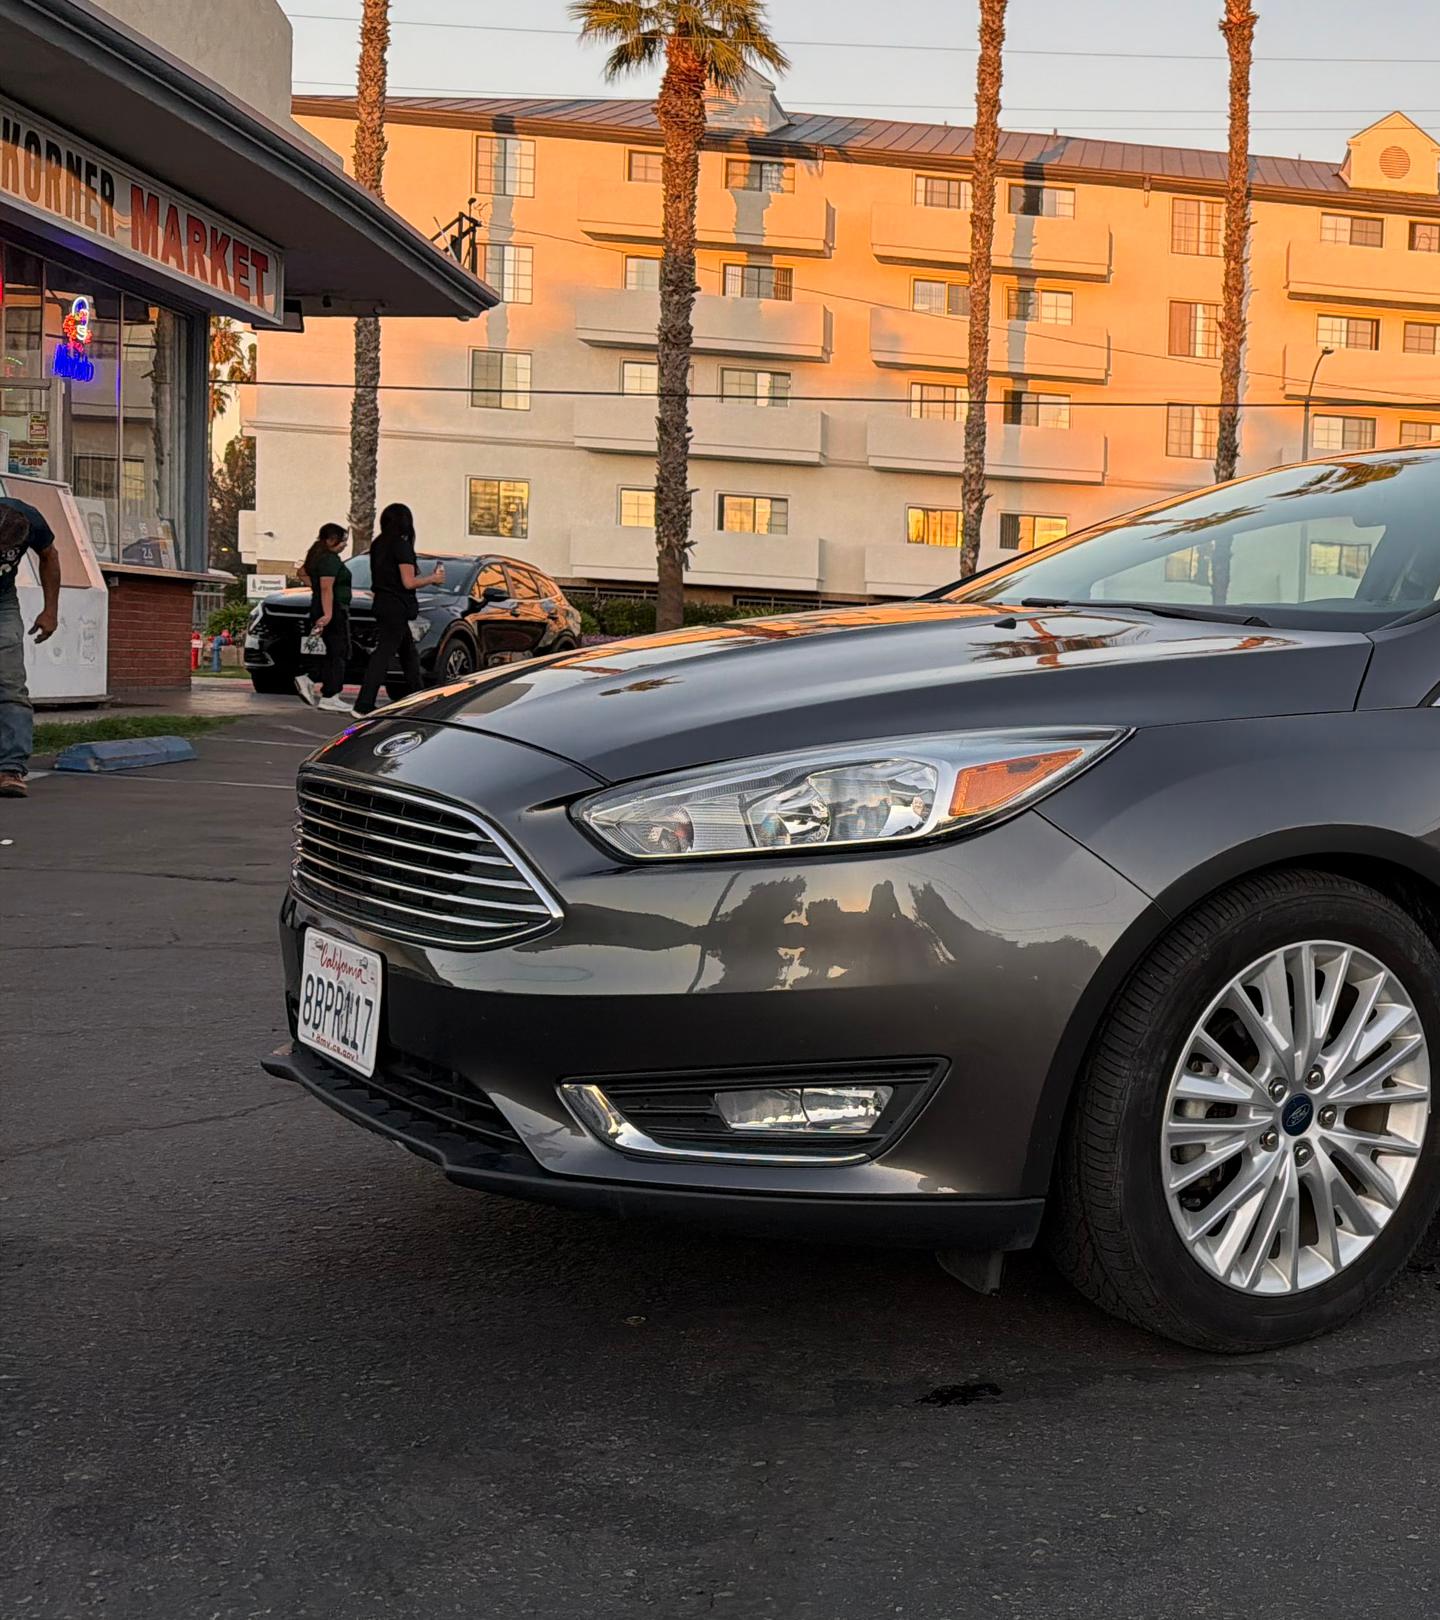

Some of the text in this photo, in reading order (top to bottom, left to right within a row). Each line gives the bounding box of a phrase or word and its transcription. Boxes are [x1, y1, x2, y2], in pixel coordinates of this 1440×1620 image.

[1, 116, 269, 308] KORNER MARKET
[320, 943, 367, 984] California
[303, 974, 373, 1055] 8BPR117
